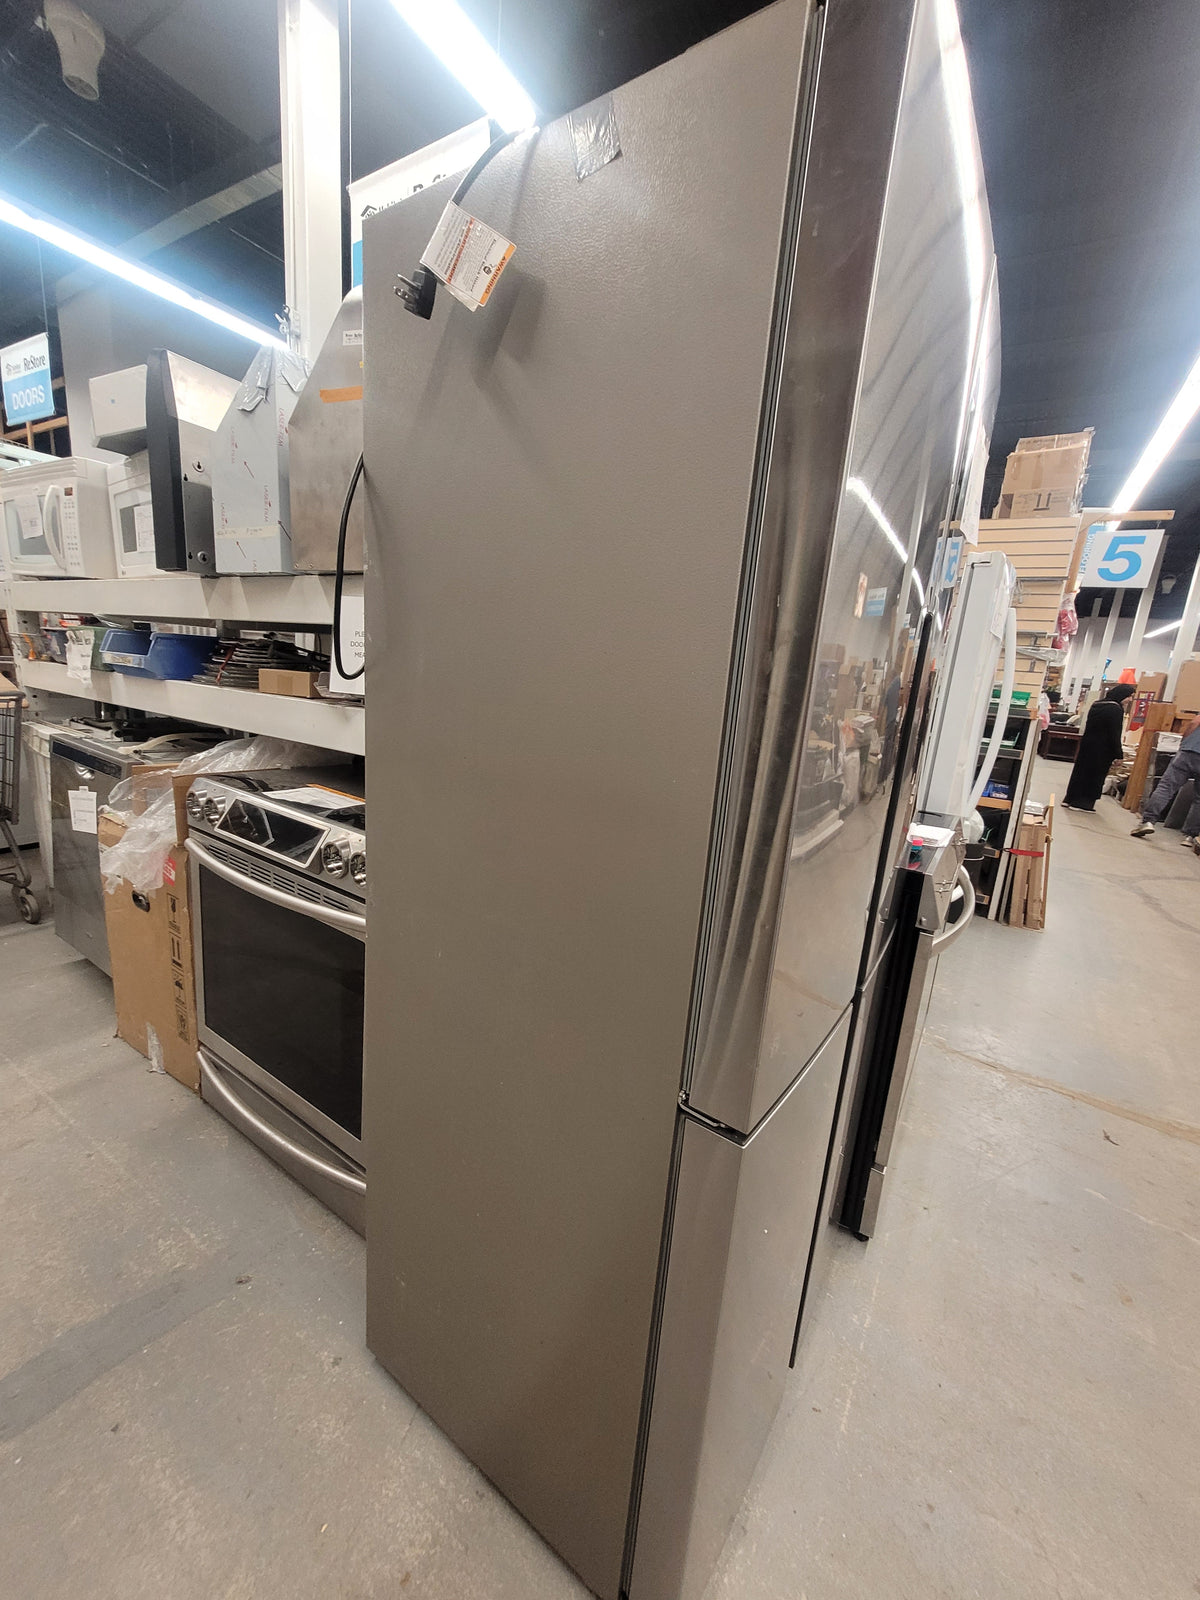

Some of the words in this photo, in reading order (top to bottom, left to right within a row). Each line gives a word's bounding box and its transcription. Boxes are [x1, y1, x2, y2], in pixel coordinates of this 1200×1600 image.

[484, 259, 504, 294] WARNING
[23, 355, 46, 371] ReStore
[12, 385, 45, 410] DOORS
[1097, 535, 1147, 582] 5
